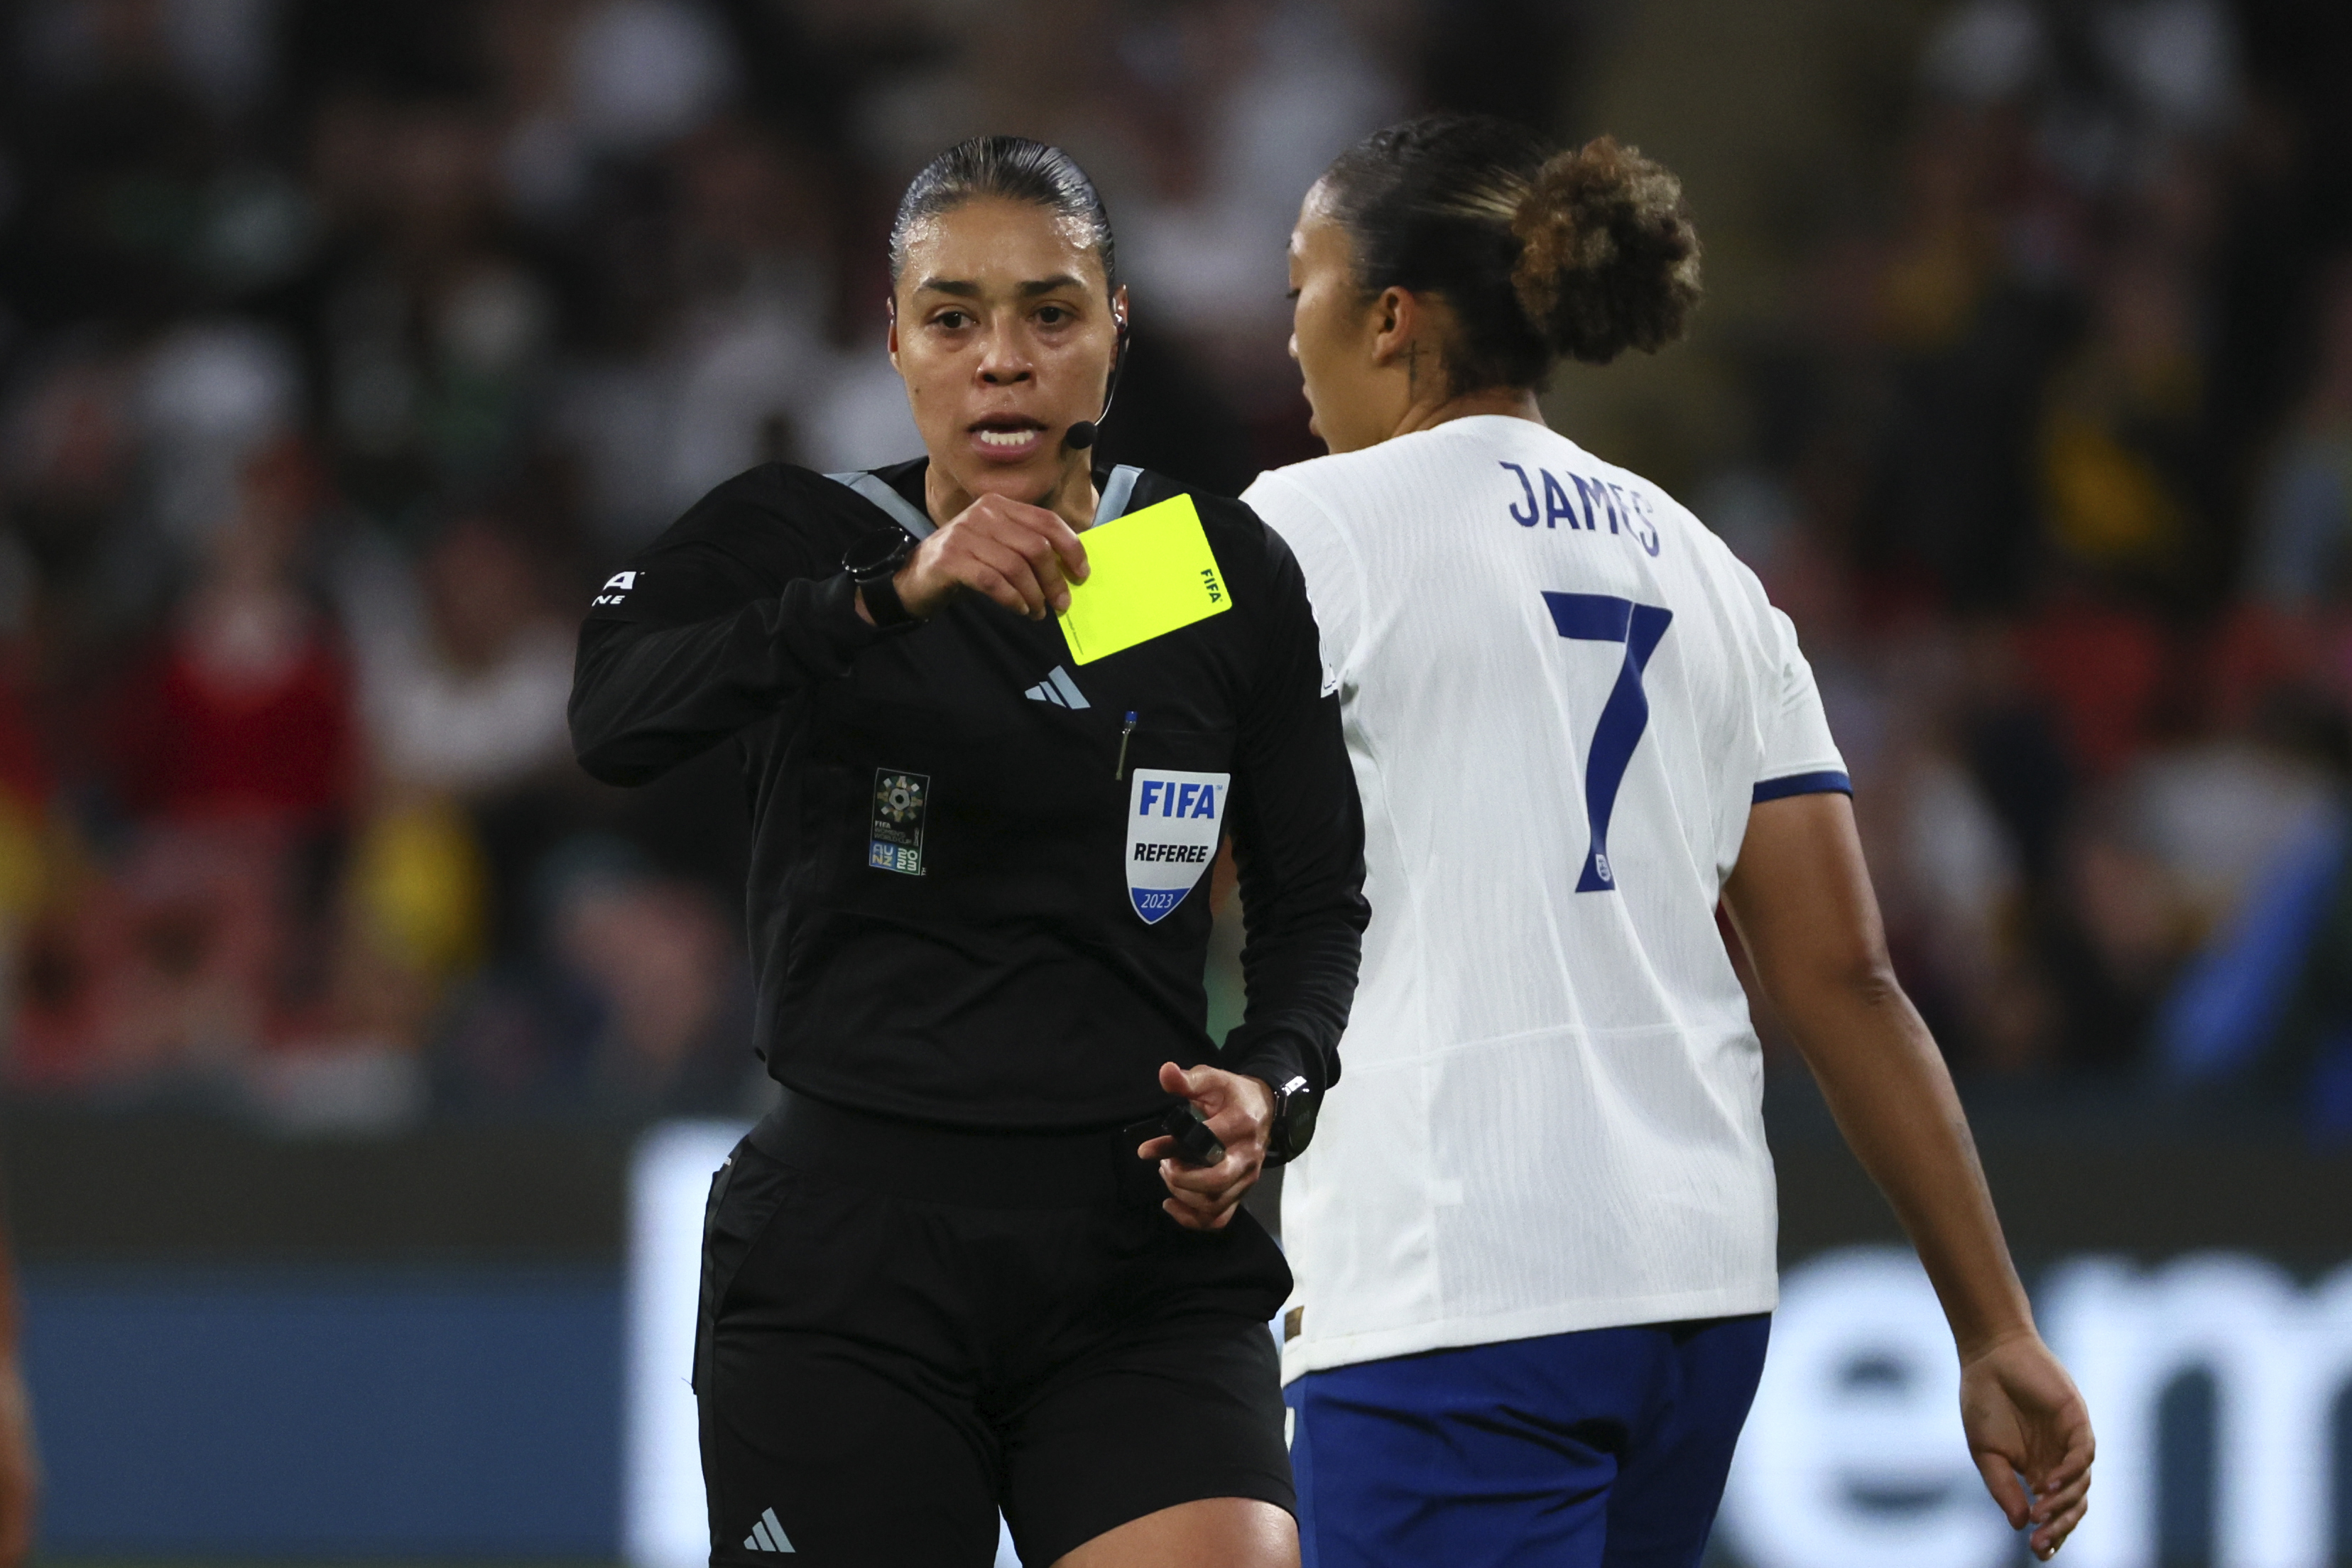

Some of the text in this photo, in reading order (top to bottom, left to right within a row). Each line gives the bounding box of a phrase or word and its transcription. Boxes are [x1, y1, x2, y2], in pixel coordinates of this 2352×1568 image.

[1498, 460, 1660, 557] JAMES
[1200, 569, 1221, 603] FIFA
[1540, 591, 1673, 893] 7
[1140, 780, 1214, 819] FIFA
[1134, 843, 1208, 863] REFEREE
[1141, 893, 1173, 908] 2023
